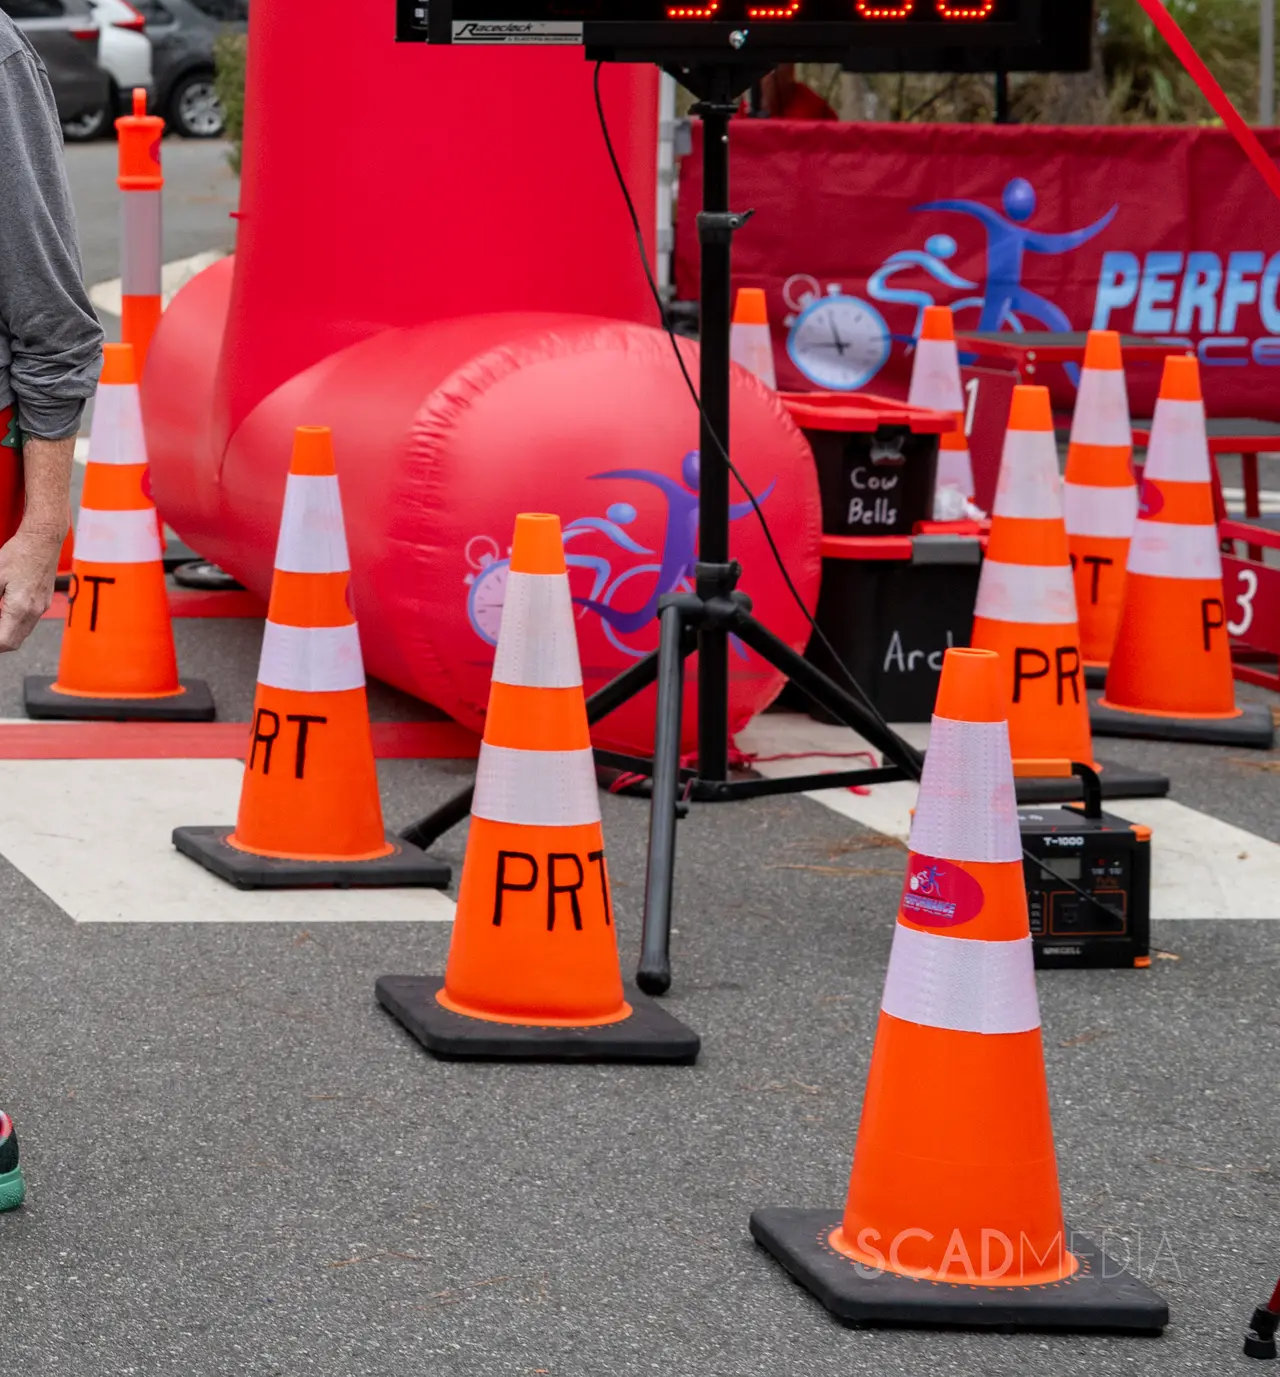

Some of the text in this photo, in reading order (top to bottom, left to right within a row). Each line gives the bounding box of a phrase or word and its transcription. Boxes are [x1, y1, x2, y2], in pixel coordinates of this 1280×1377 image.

[964, 378, 979, 437] 1
[850, 466, 899, 491] Cow
[847, 497, 898, 525] Bells
[1227, 569, 1258, 636] 3
[1043, 836, 1085, 846] T-1000
